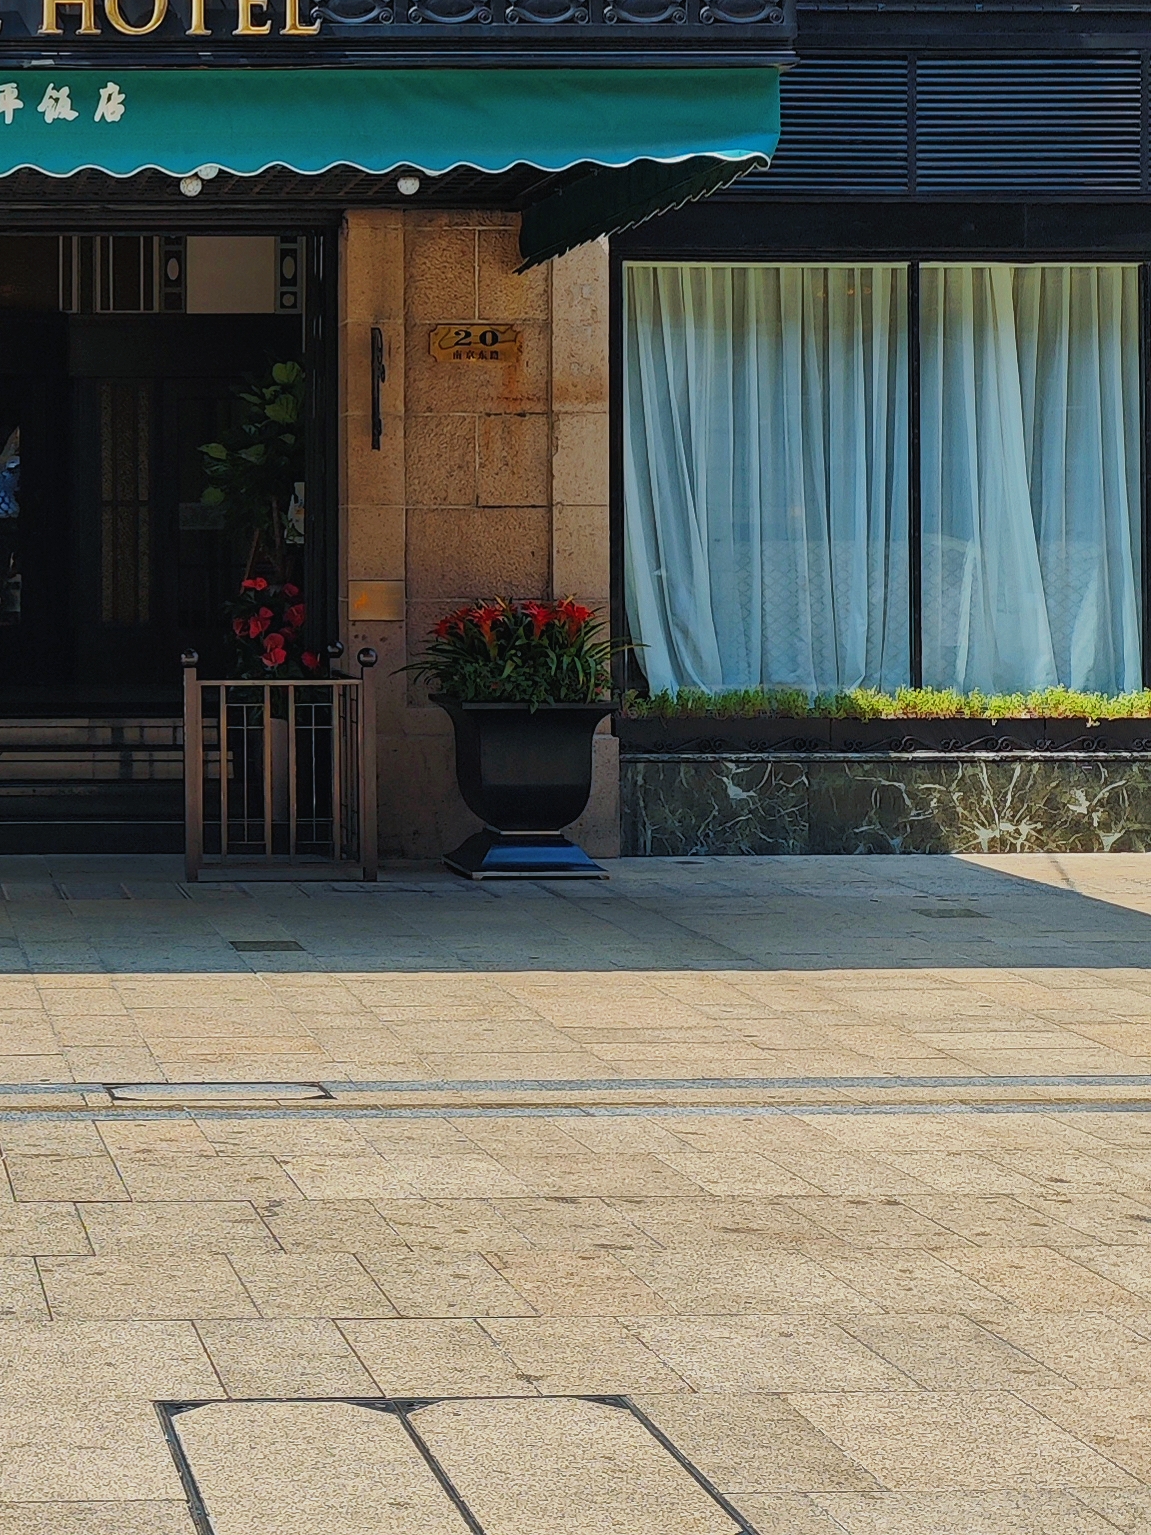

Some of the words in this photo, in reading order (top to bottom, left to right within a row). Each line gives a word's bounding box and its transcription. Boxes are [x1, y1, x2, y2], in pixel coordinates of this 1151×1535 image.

[454, 329, 499, 347] 20
[453, 350, 499, 360] 南京东路
